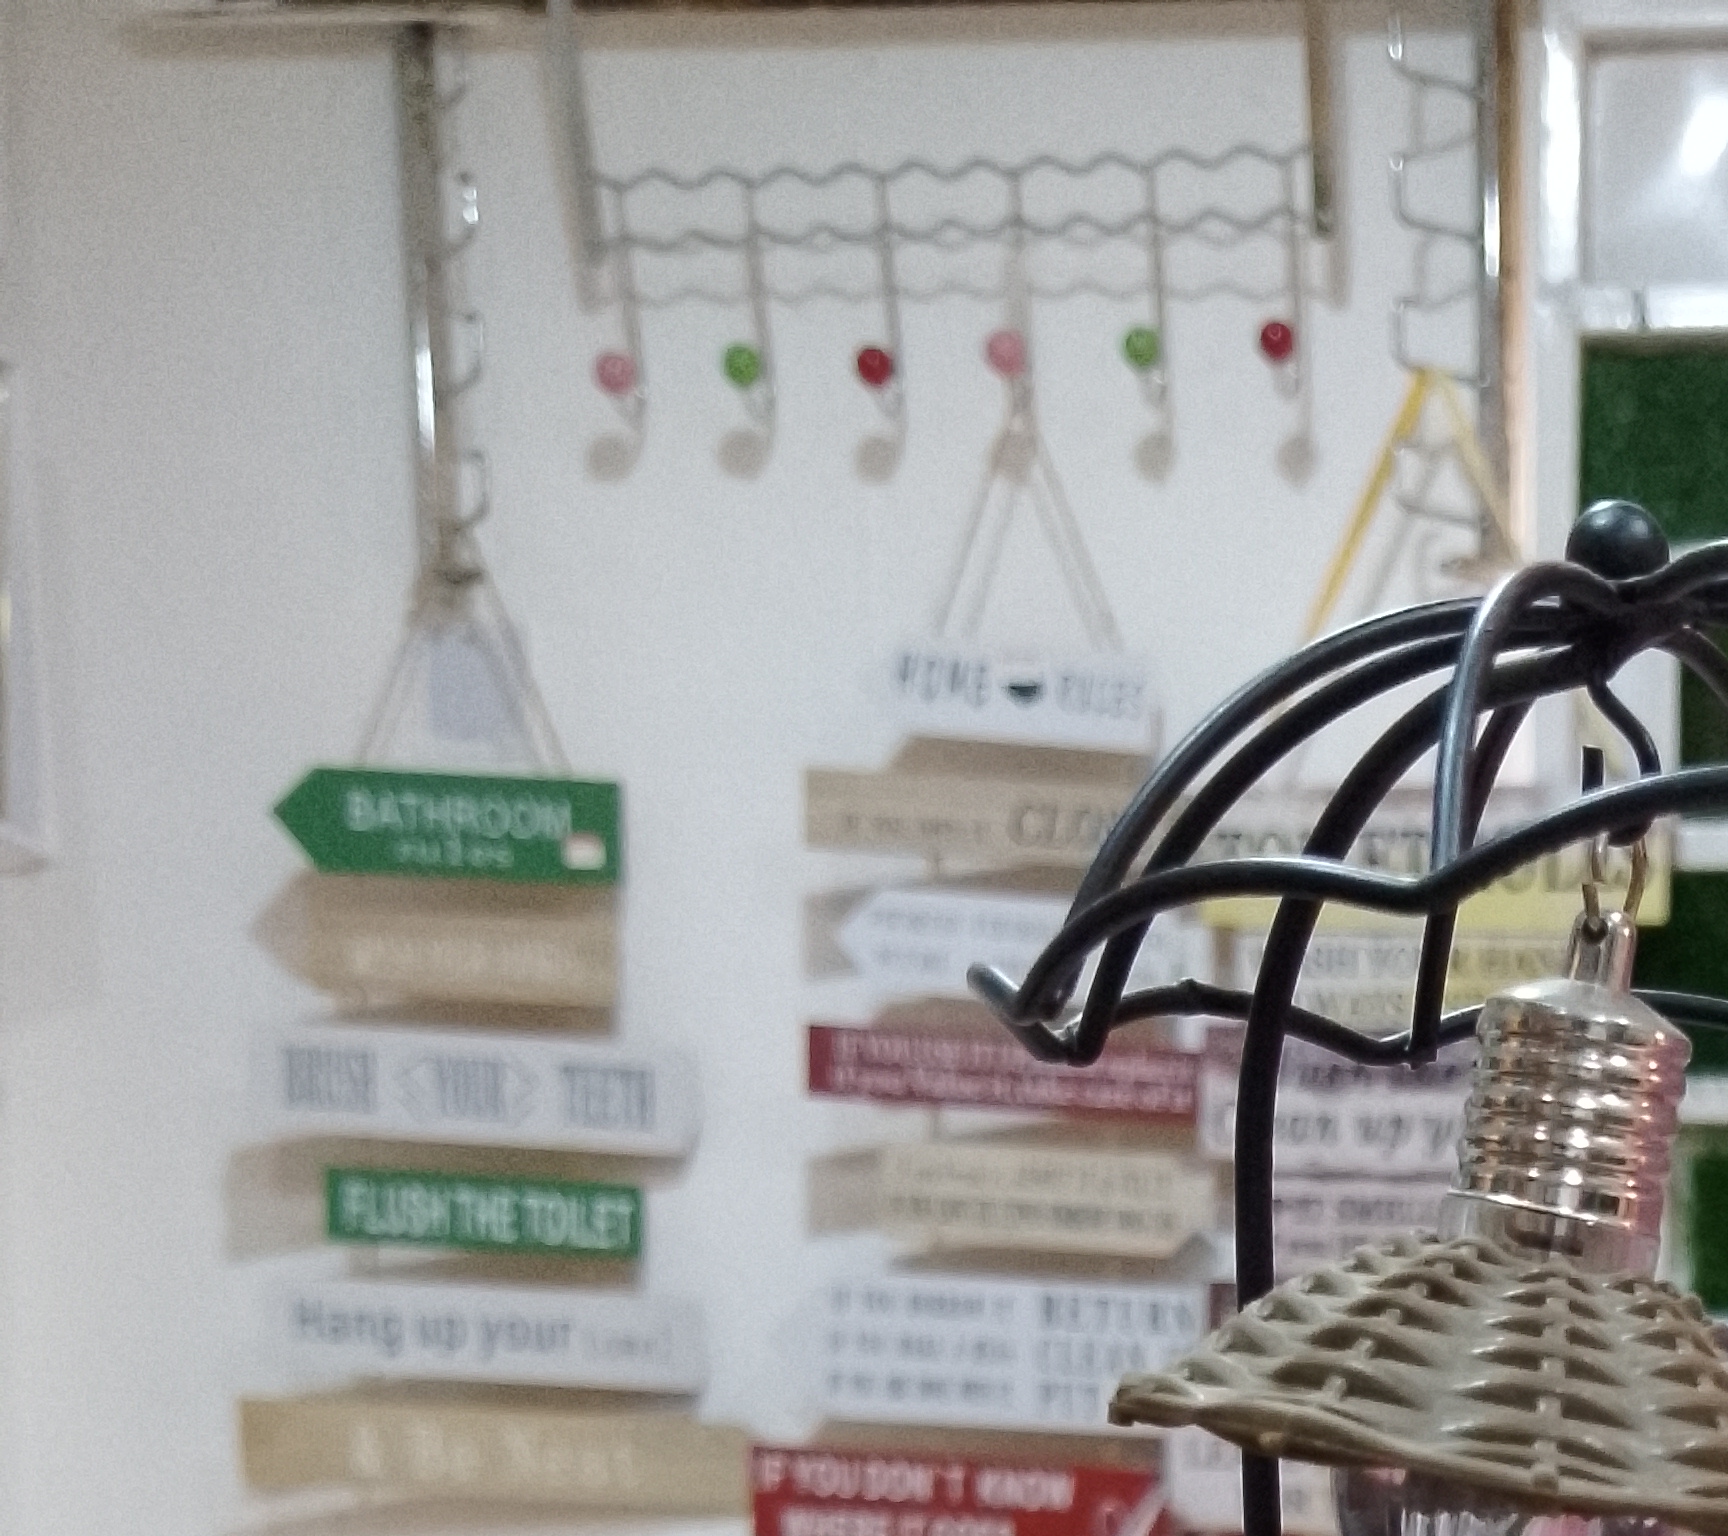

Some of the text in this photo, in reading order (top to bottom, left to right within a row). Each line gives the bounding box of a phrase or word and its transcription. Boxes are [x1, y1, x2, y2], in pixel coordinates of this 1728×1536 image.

[344, 786, 573, 842] BATHROOM
[340, 1177, 635, 1252] FLUSH THE TOILET
[292, 1298, 404, 1357] Hang
[416, 1309, 467, 1354] up
[477, 1314, 573, 1362] your
[758, 1458, 789, 1492] IF
[793, 1459, 861, 1500] YOU
[976, 1470, 1077, 1512] KNOW
